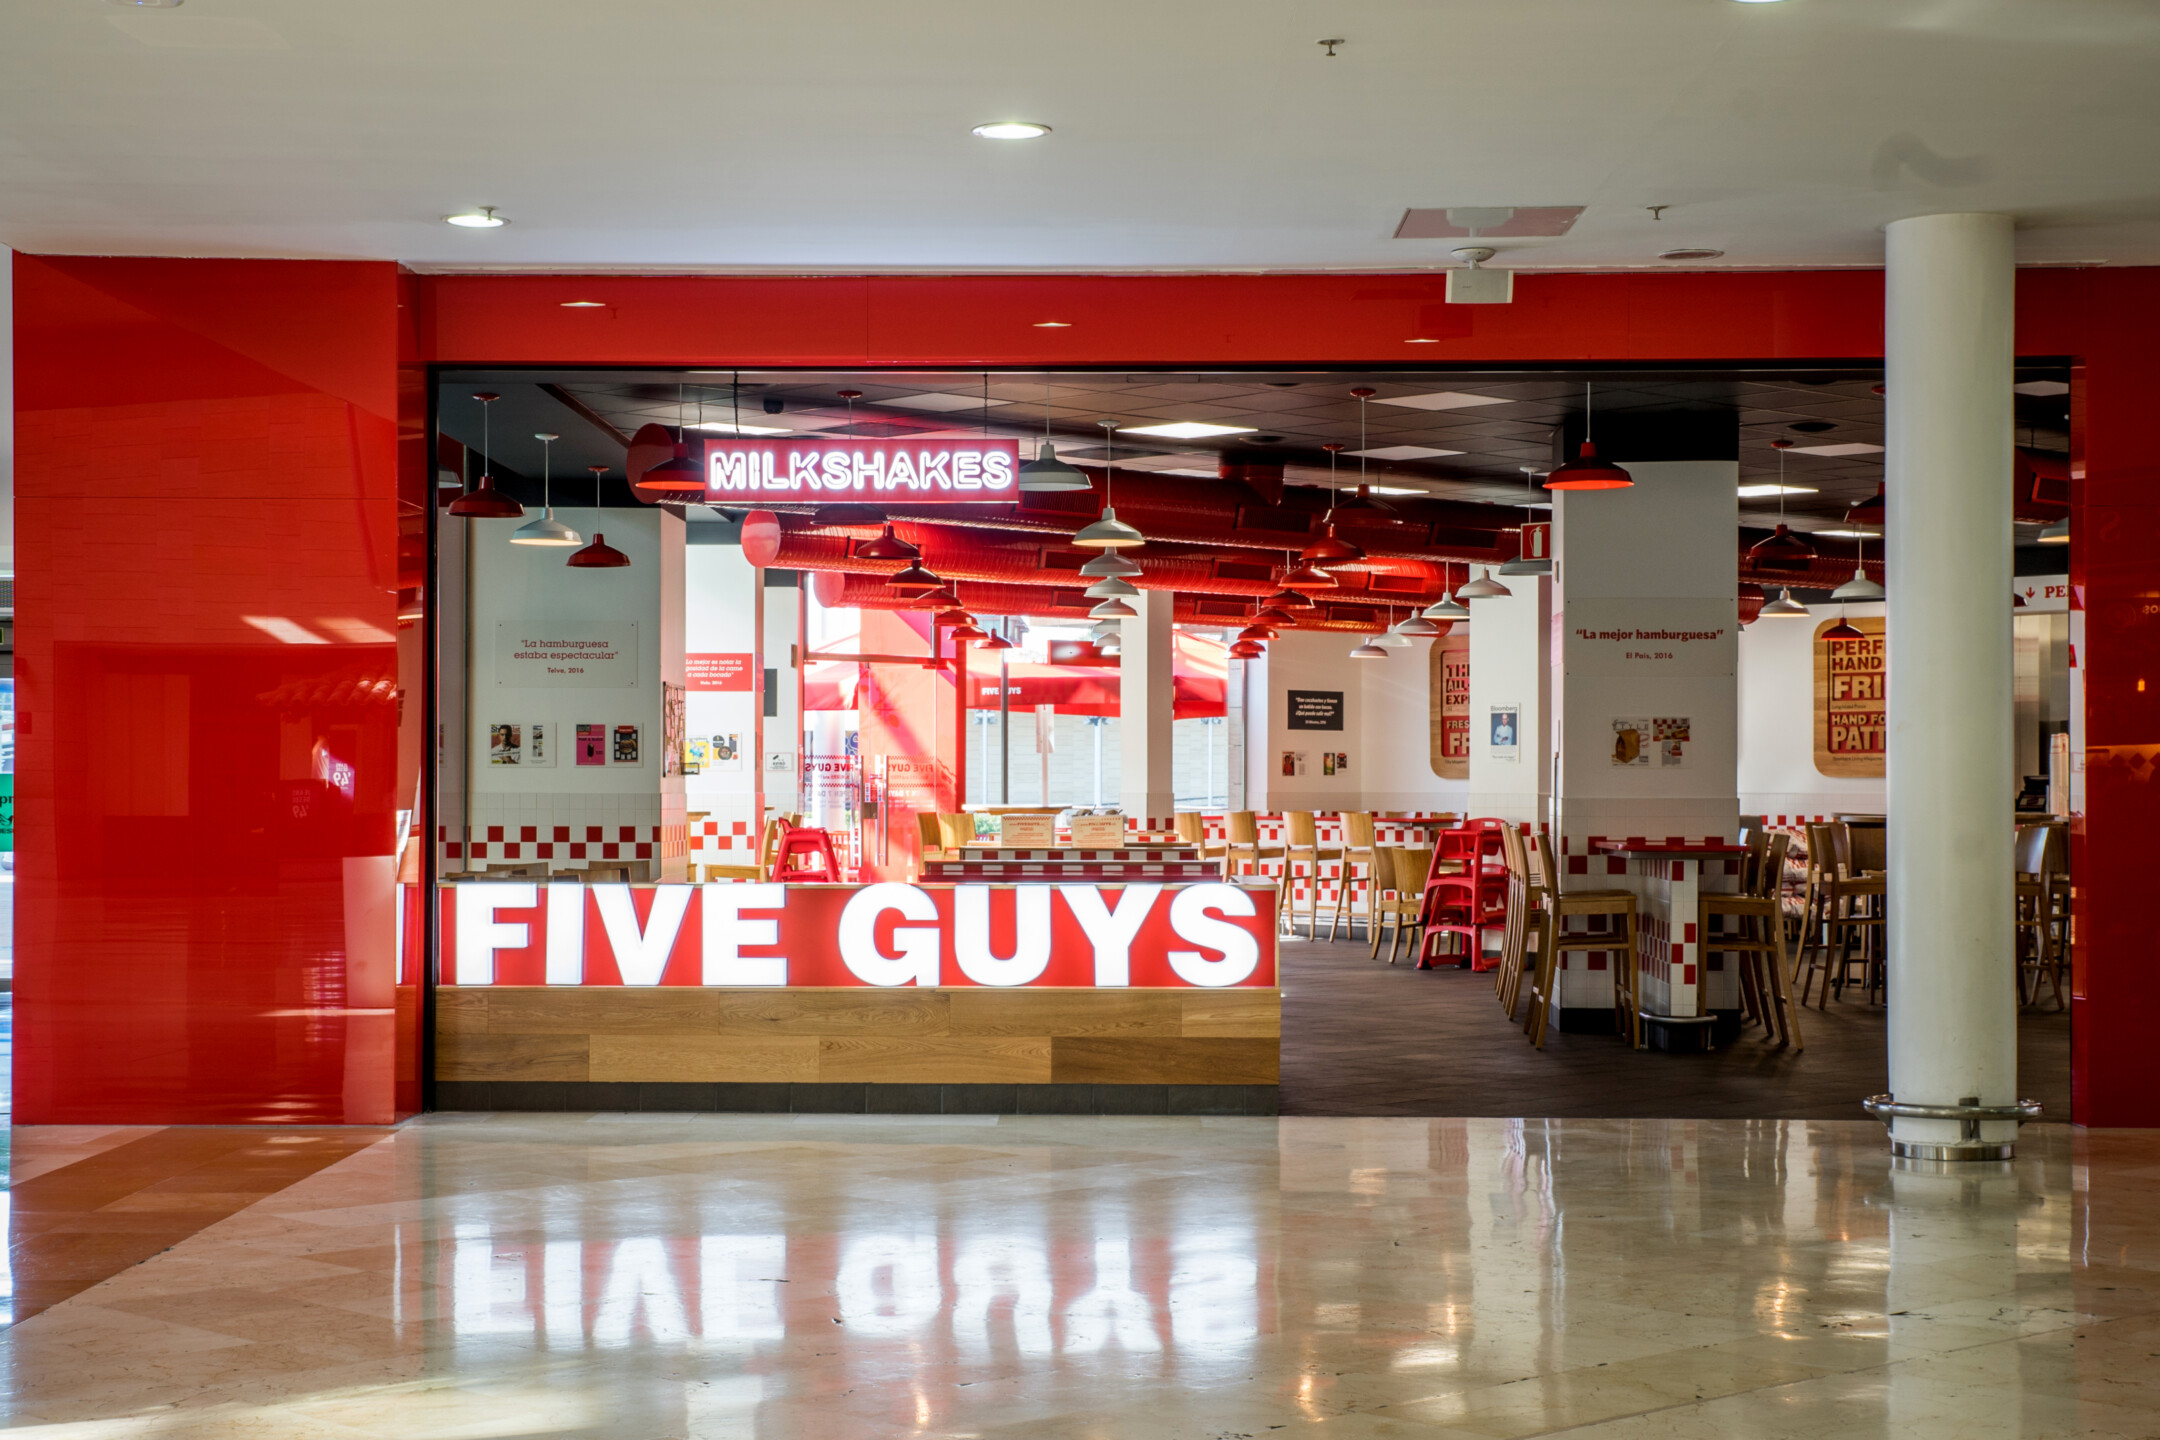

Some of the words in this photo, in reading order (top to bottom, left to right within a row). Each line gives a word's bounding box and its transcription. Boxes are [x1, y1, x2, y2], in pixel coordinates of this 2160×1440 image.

[710, 451, 1013, 490] MILKSHAKES
[1600, 629, 1633, 642] mejor
[540, 640, 609, 649] hamburguesa
[1832, 656, 1883, 671] HAND
[981, 687, 1000, 696] FIVE
[1490, 705, 1518, 714] Bloomberg
[1832, 714, 1868, 725] HAND
[1832, 726, 1886, 750] PATT
[455, 883, 788, 986] FIVE
[838, 882, 1259, 987] GUYS
